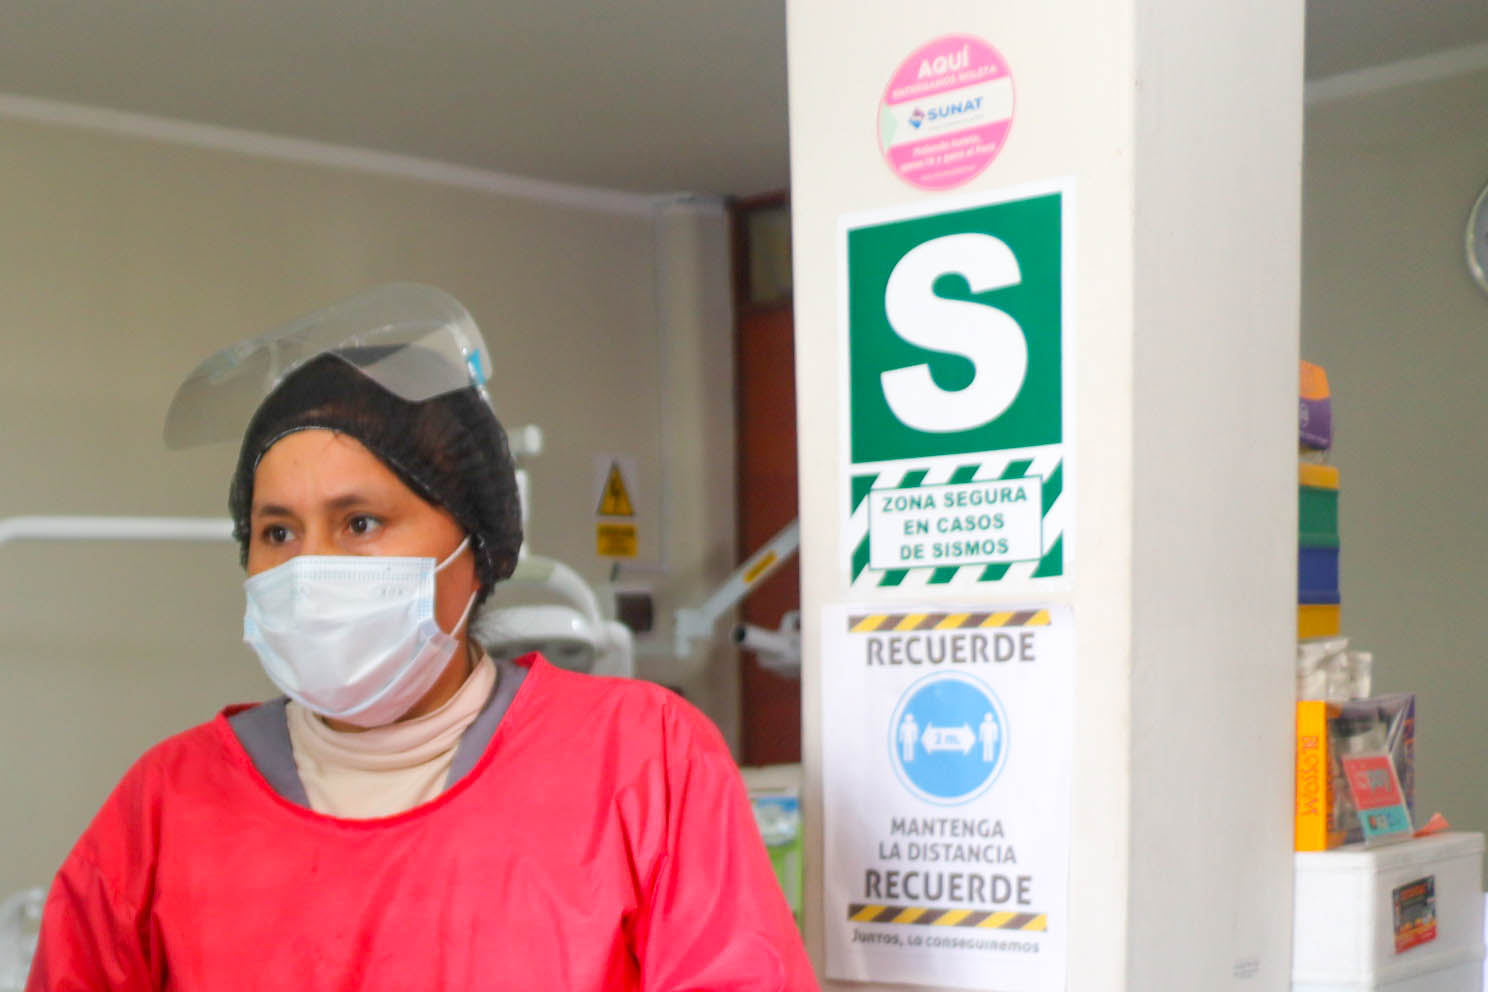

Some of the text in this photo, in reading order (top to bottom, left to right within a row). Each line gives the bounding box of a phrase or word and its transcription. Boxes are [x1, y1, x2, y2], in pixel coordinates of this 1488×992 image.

[927, 96, 984, 121] SUNAT
[880, 231, 1028, 434] S
[882, 485, 1028, 513] ZONA SEGURA
[903, 513, 1005, 536] EN CASOS
[899, 538, 1009, 561] DE SISMOS
[865, 632, 1036, 667] RECUERDE
[889, 817, 1004, 838] MANTENGA
[878, 843, 1017, 864] LA DISTANCIA
[864, 869, 1032, 905] RECUERDE
